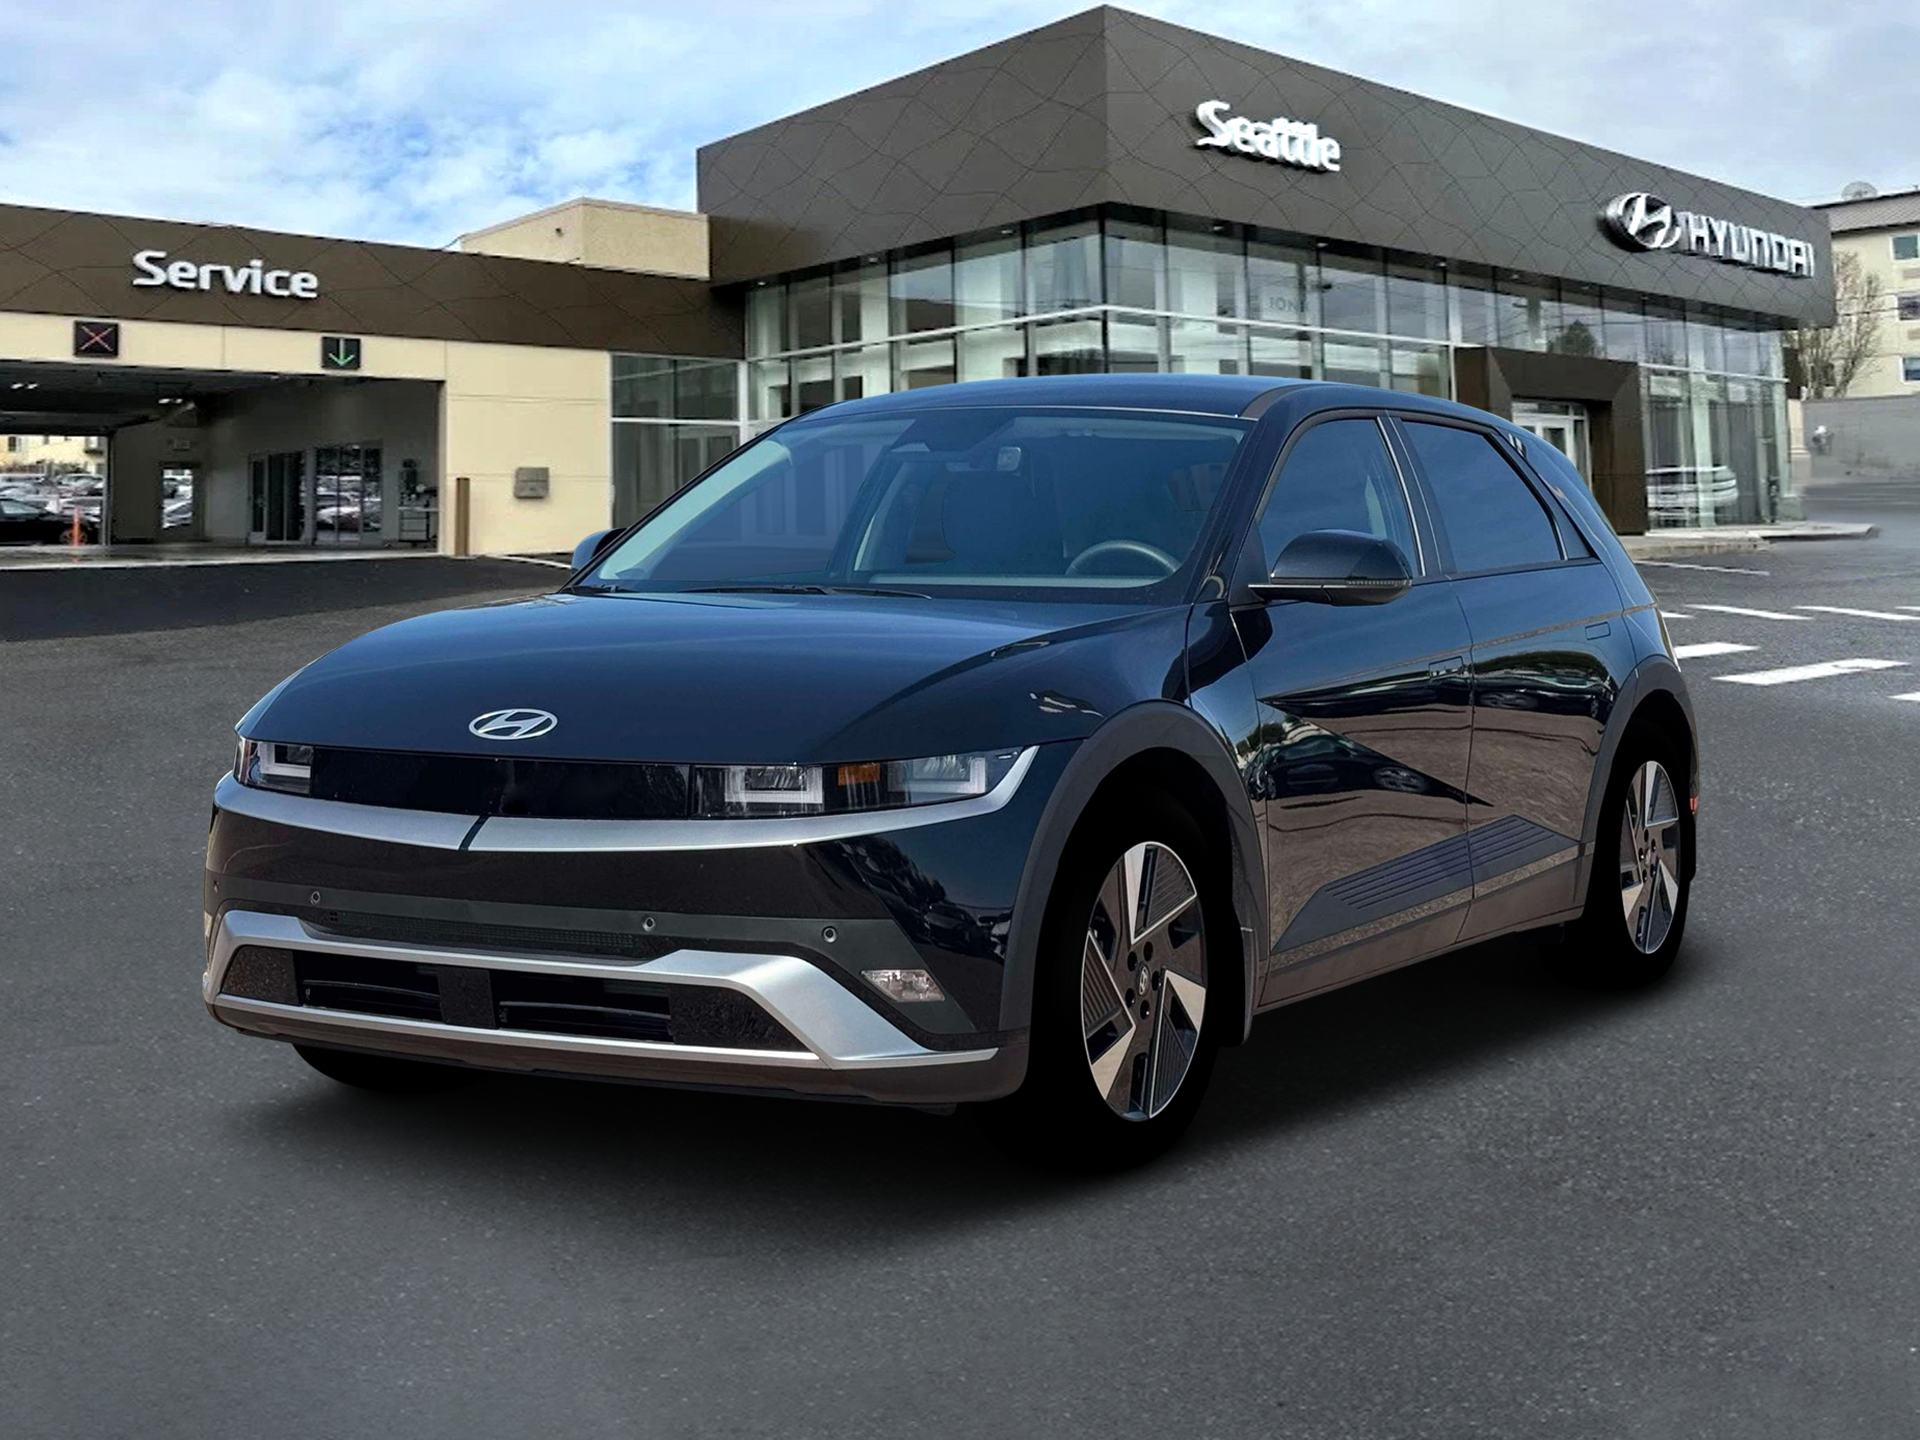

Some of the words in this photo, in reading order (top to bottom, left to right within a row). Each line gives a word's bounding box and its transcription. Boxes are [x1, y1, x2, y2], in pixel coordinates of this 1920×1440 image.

[1196, 100, 1341, 172] Seattle
[132, 250, 319, 299] Service
[1678, 211, 1815, 278] HYUNDAI
